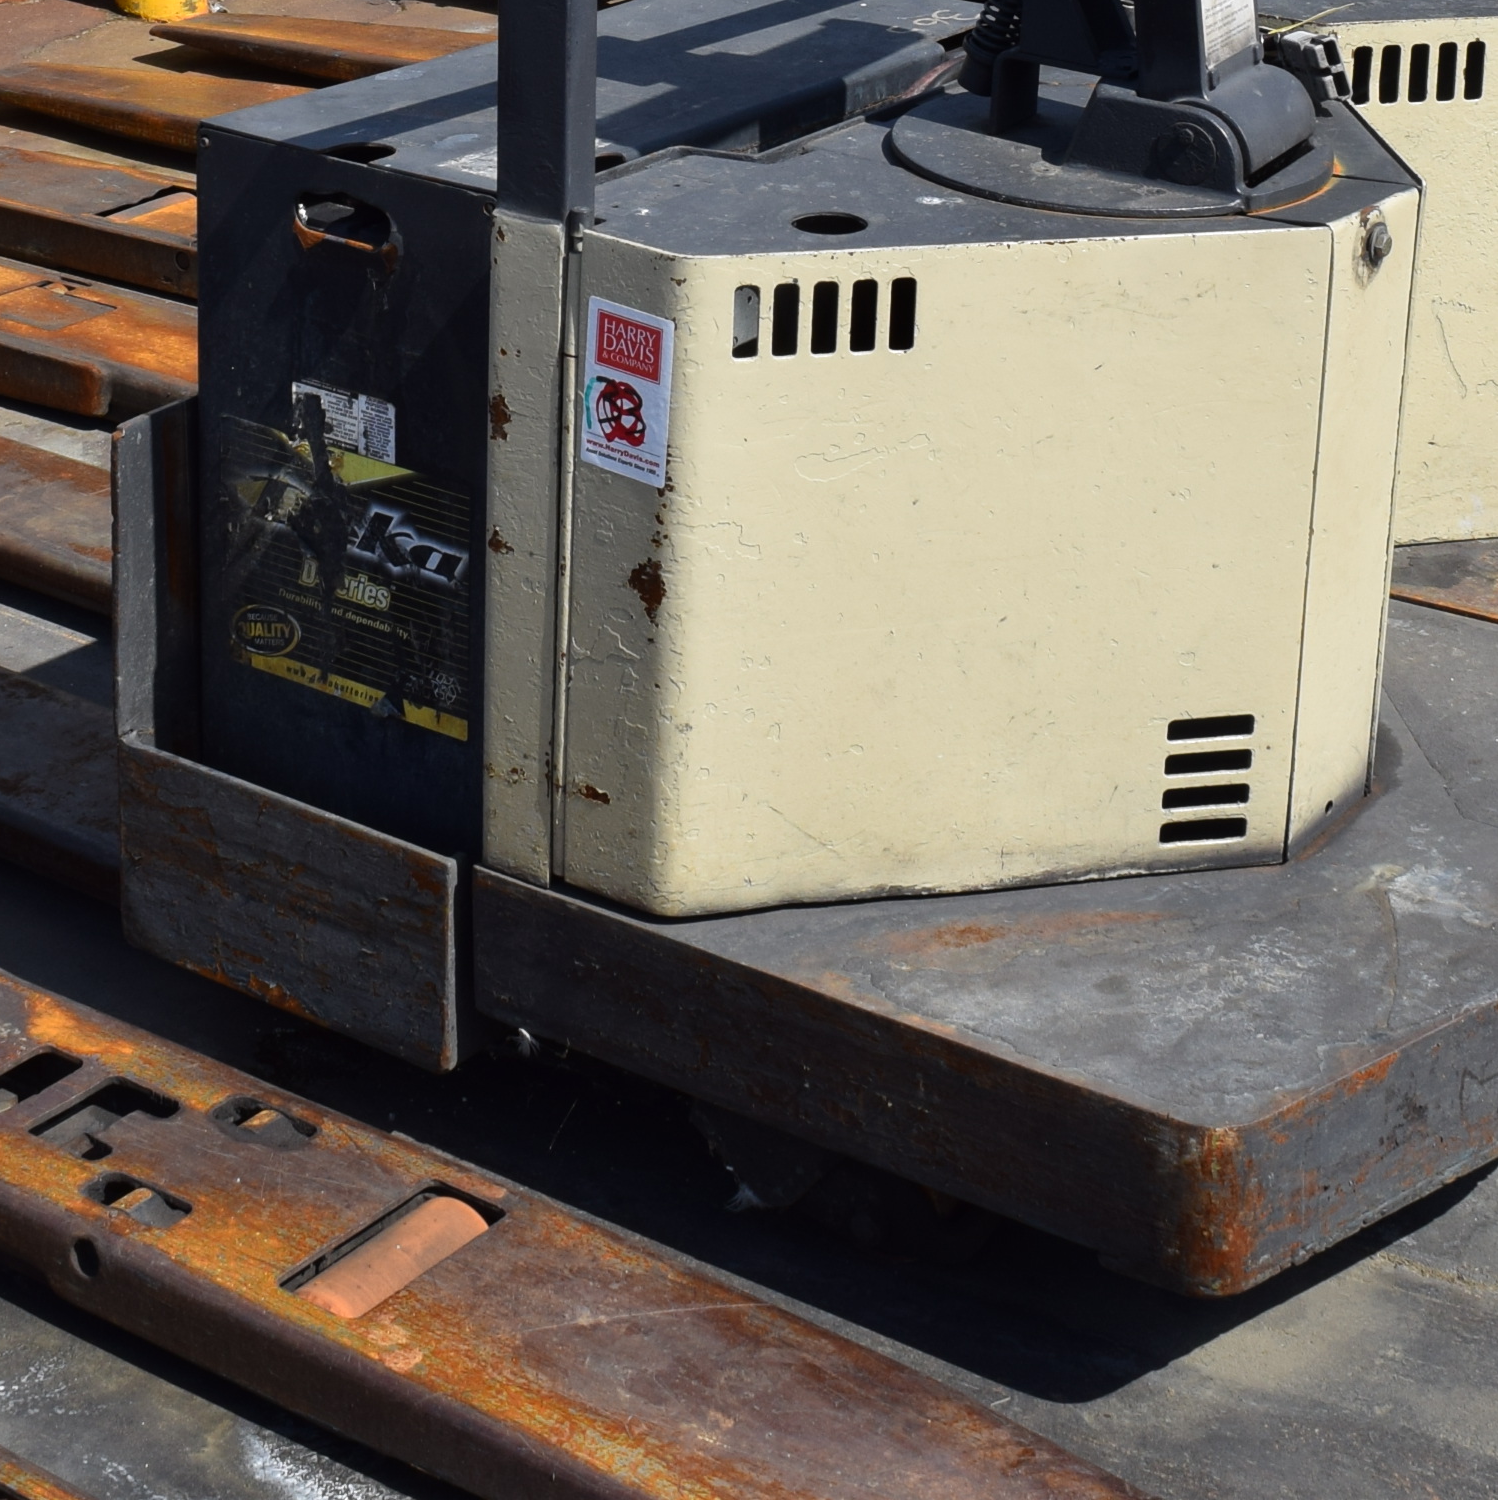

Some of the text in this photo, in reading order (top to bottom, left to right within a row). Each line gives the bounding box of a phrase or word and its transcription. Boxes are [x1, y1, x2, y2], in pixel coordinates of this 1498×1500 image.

[603, 332, 654, 364] DAVIS
[604, 318, 656, 348] HARRY
[602, 351, 654, 374] & COMPANY
[586, 438, 660, 468] www.HarryDavis.com
